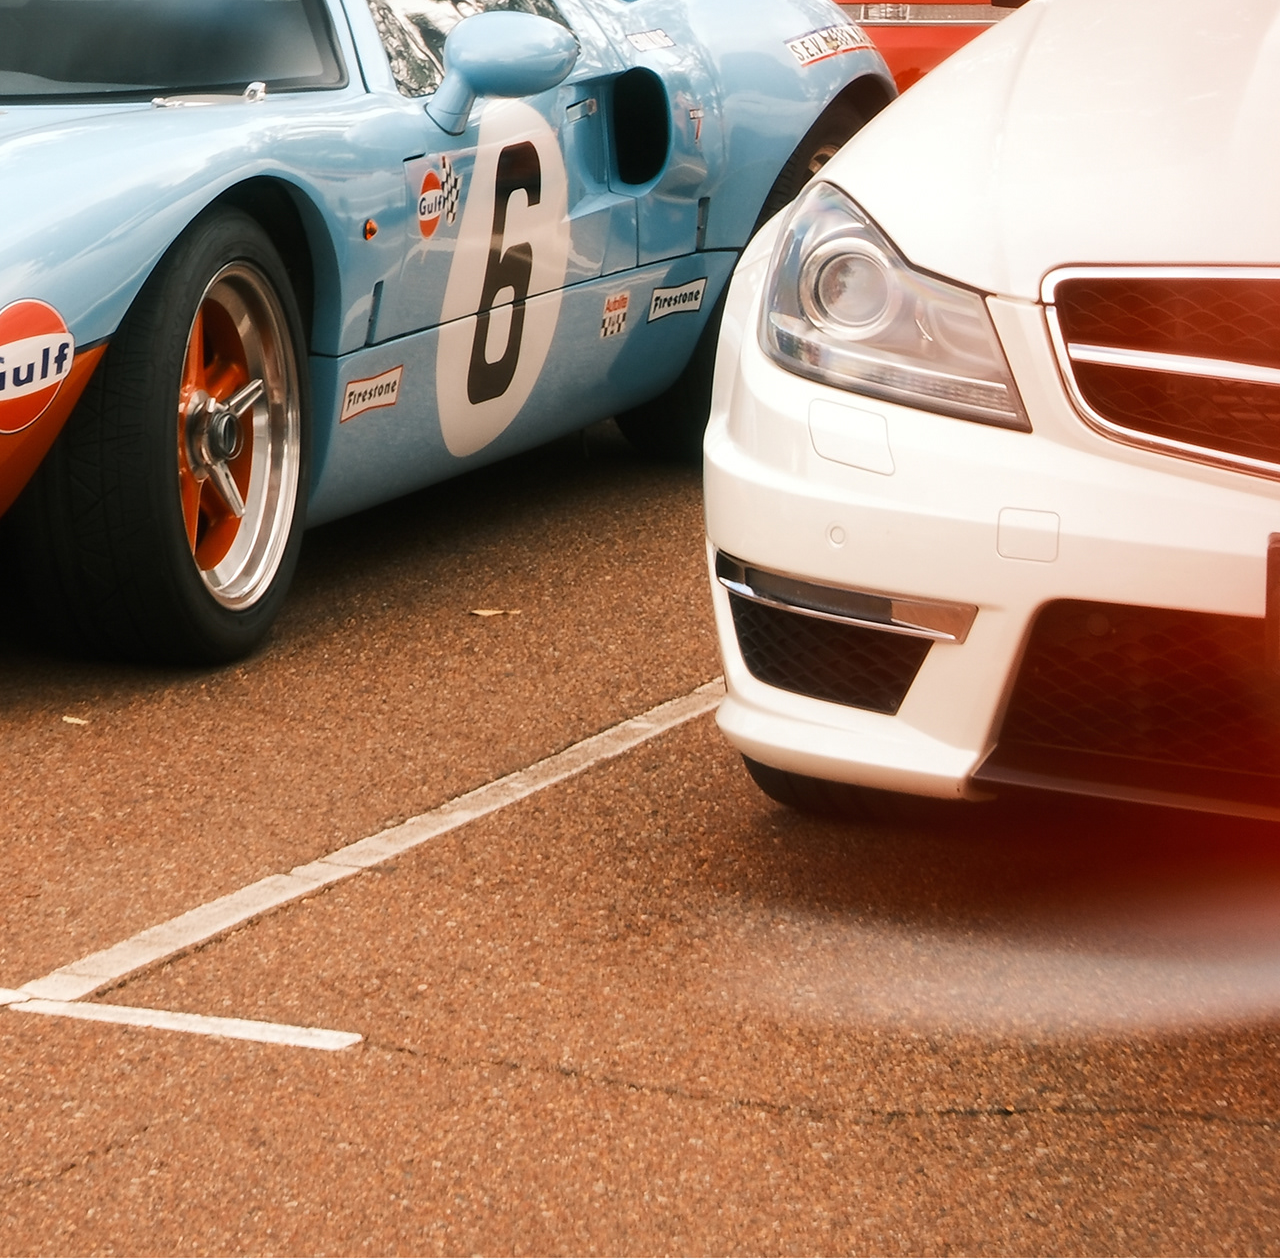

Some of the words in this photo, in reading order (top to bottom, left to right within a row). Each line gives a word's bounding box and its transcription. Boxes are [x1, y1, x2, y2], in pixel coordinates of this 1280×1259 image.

[467, 140, 541, 405] 6
[652, 288, 700, 313] Firestone
[346, 378, 397, 412] Firestone
